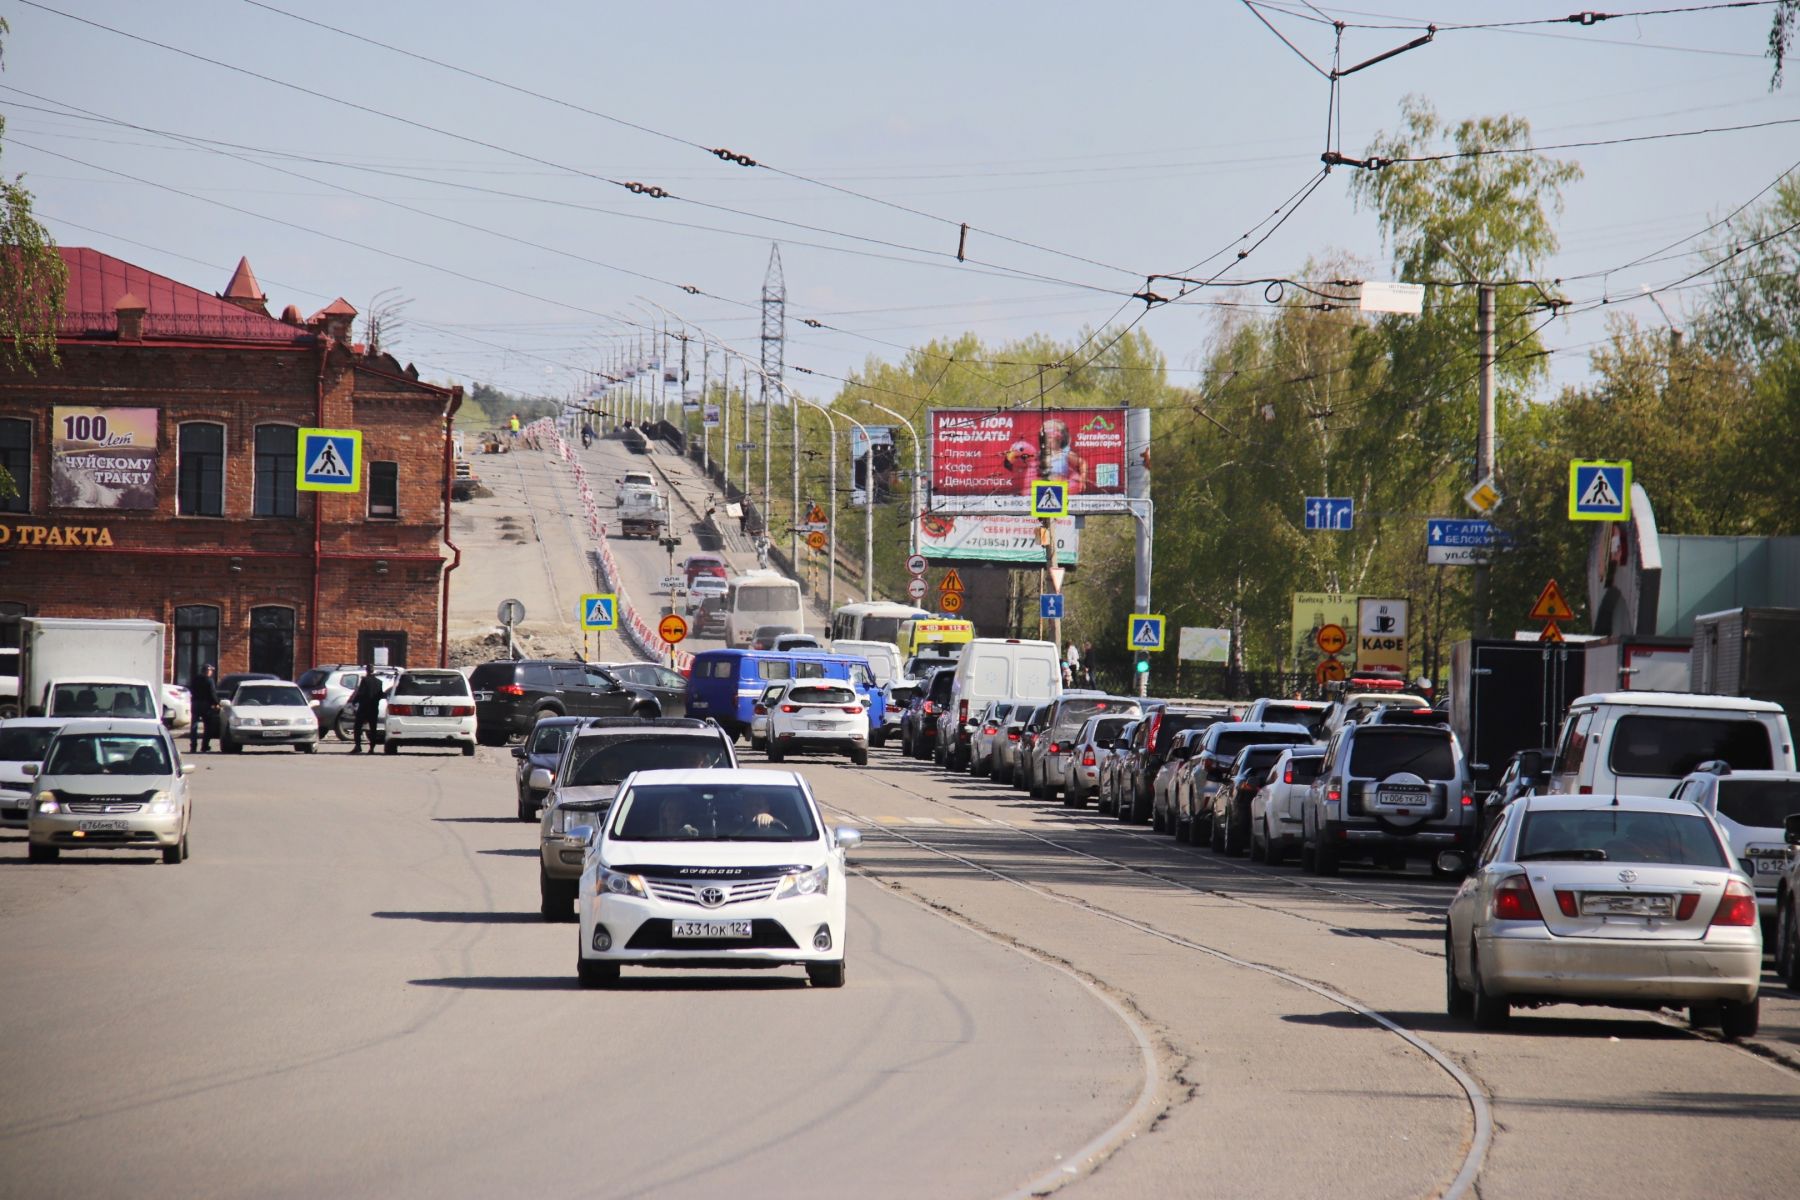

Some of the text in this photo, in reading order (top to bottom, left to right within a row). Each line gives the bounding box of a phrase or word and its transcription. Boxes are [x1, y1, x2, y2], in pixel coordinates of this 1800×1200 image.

[63, 415, 107, 441] 100
[980, 417, 1014, 429] ПОРА
[938, 430, 1011, 443] ОТДЫХАТЬ!
[65, 455, 152, 471] ЧУЙСКОМУ
[95, 472, 152, 485] ТРАКТУ
[16, 525, 114, 546] ТРАКТА
[944, 597, 958, 607] 50
[1363, 638, 1404, 651] КАФЕ
[677, 922, 750, 936] А331ОК 122
